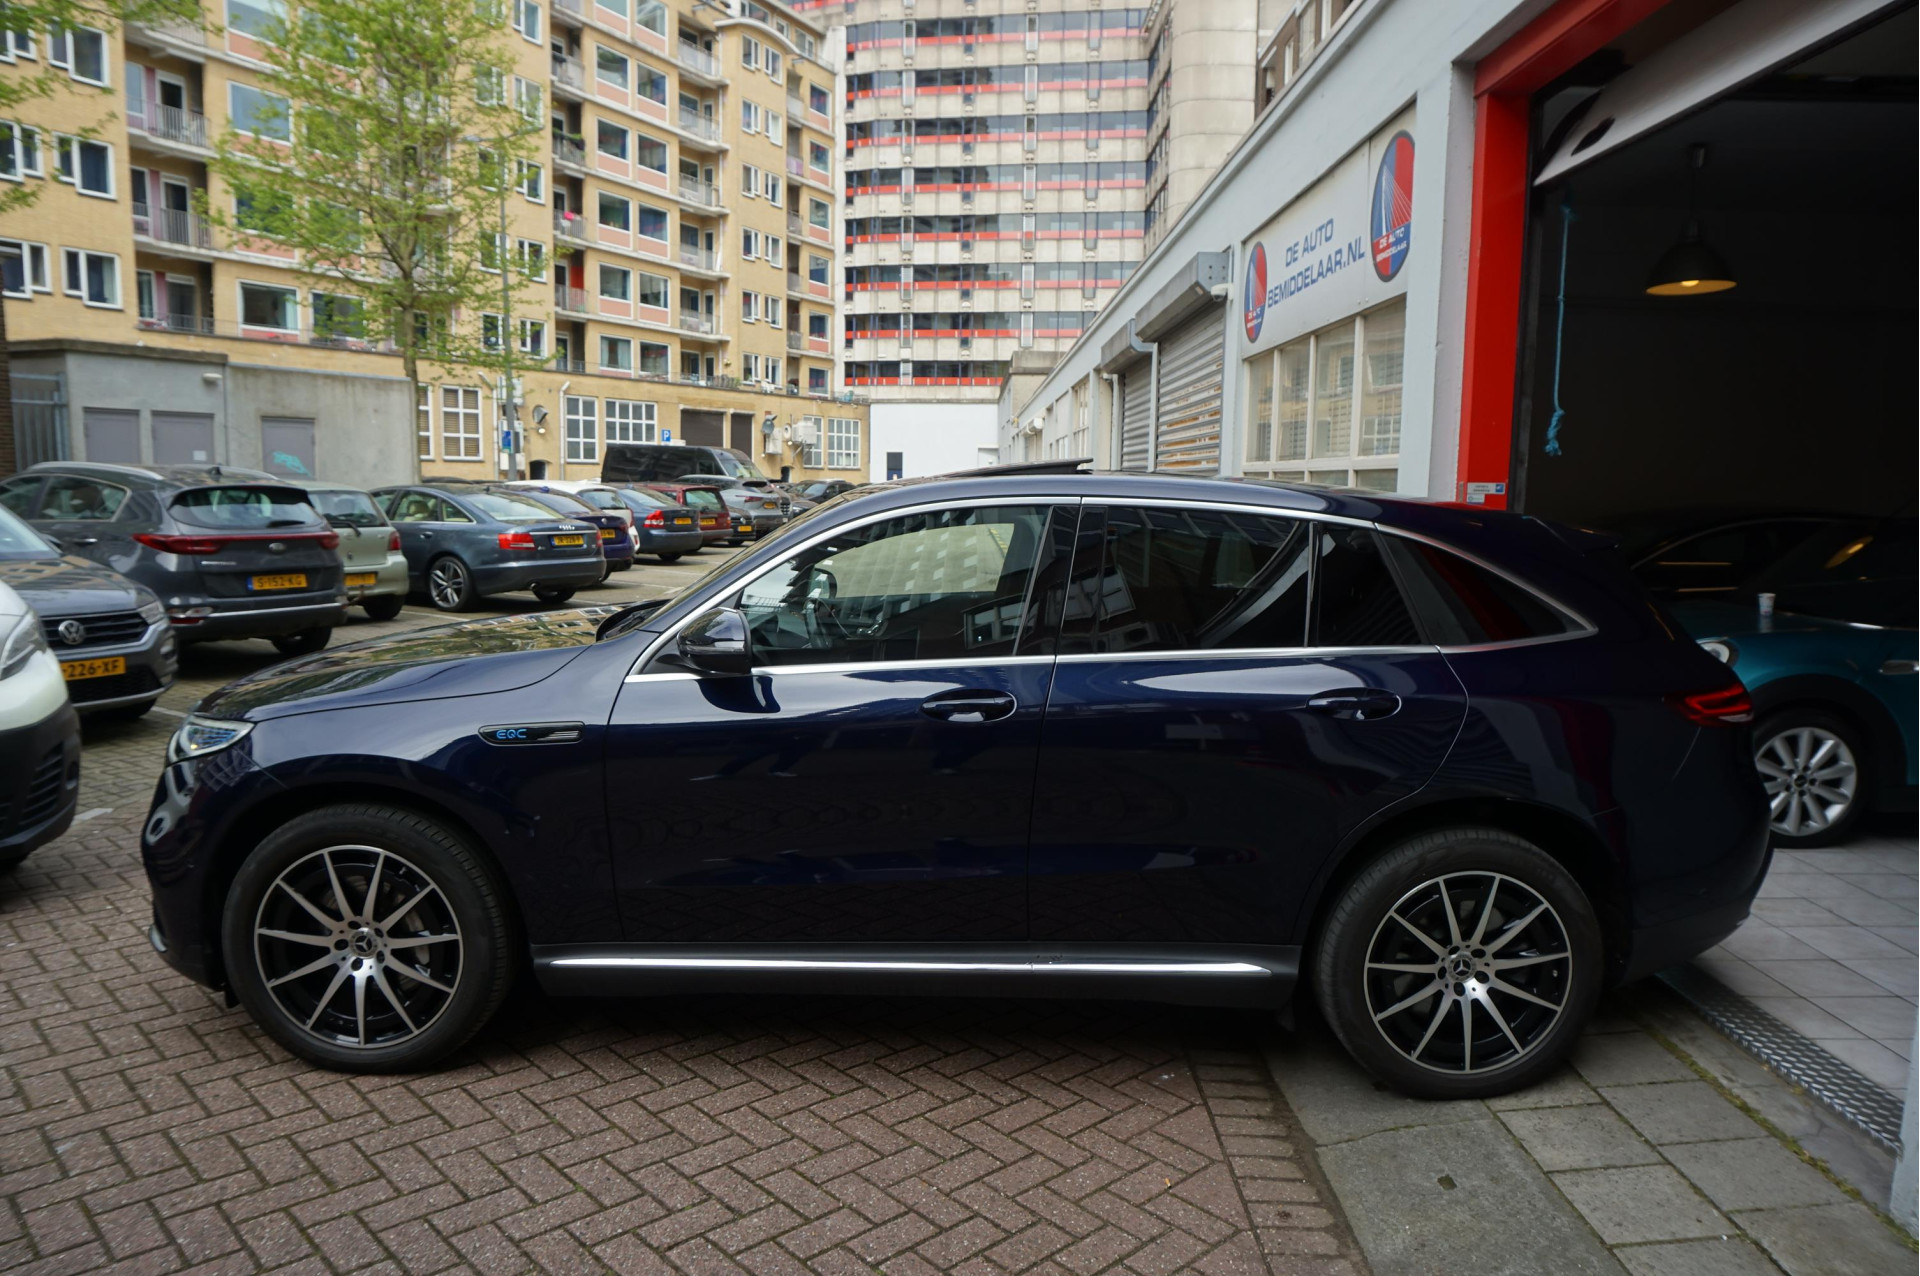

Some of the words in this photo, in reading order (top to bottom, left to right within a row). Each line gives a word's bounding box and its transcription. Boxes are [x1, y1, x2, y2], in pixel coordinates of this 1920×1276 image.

[1285, 241, 1300, 268] DE
[1301, 217, 1335, 257] AUTO
[1267, 235, 1366, 309] BEMIDDELAAR.NL
[61, 659, 121, 678] -226-XF
[496, 728, 528, 740] EQC
